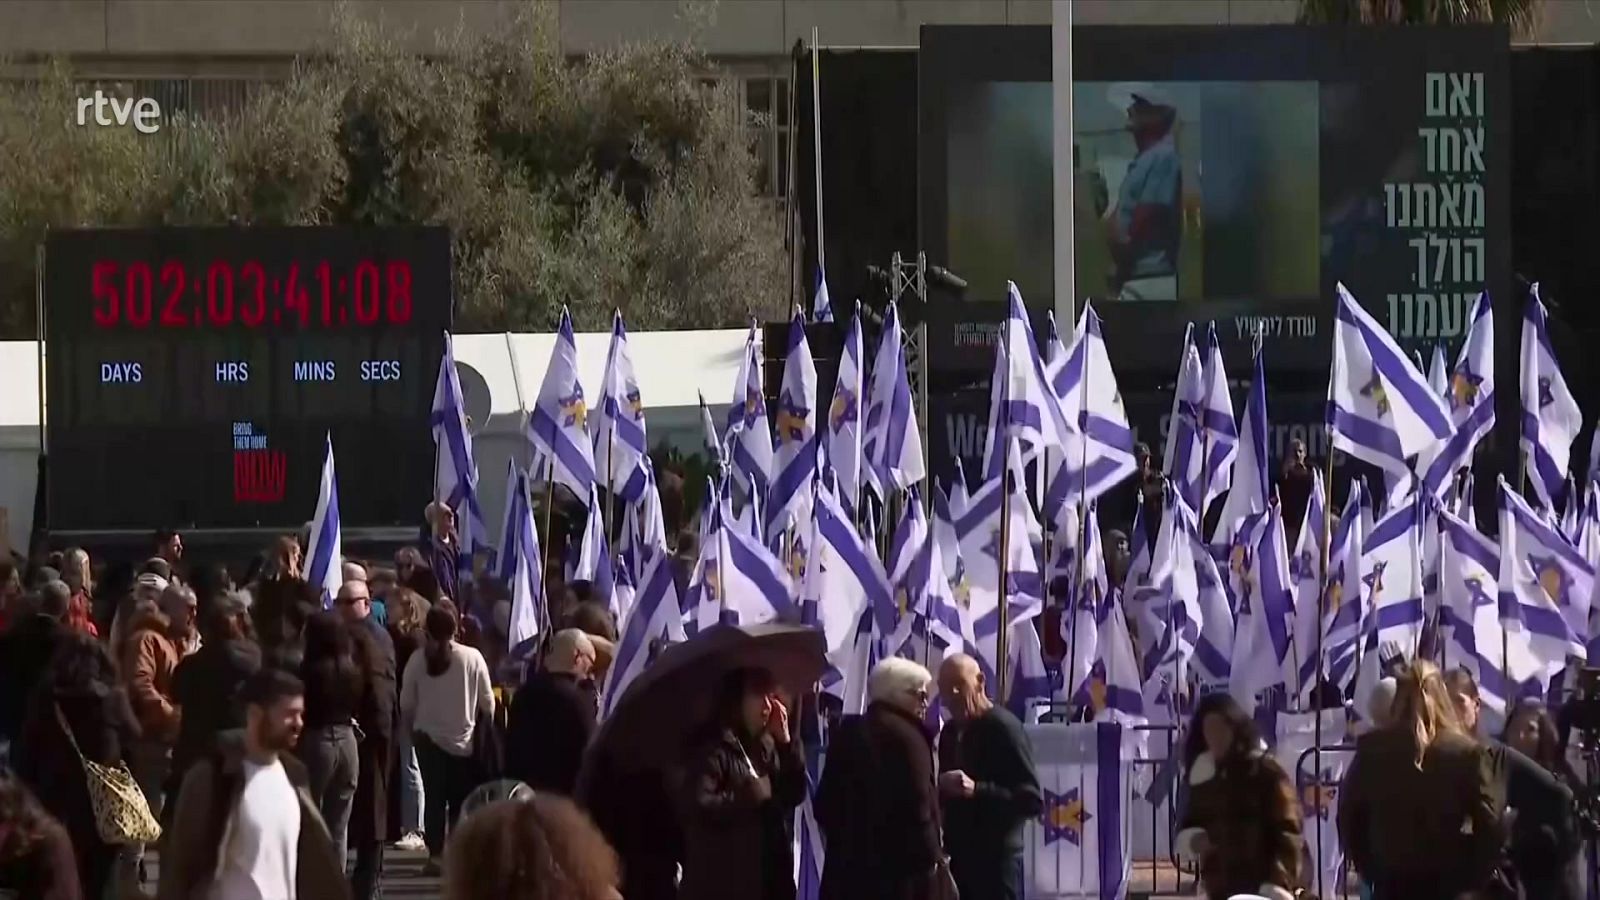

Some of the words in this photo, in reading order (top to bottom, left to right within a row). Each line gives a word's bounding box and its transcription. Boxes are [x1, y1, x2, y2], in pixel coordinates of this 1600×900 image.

[92, 259, 413, 328] 502:03:41:08
[101, 363, 142, 382] DAYS
[216, 362, 248, 382] HRS
[294, 361, 335, 381] MINS
[360, 361, 400, 380] SECS
[233, 421, 252, 436] BRING
[234, 436, 250, 450] THEM
[250, 435, 267, 449] HOME
